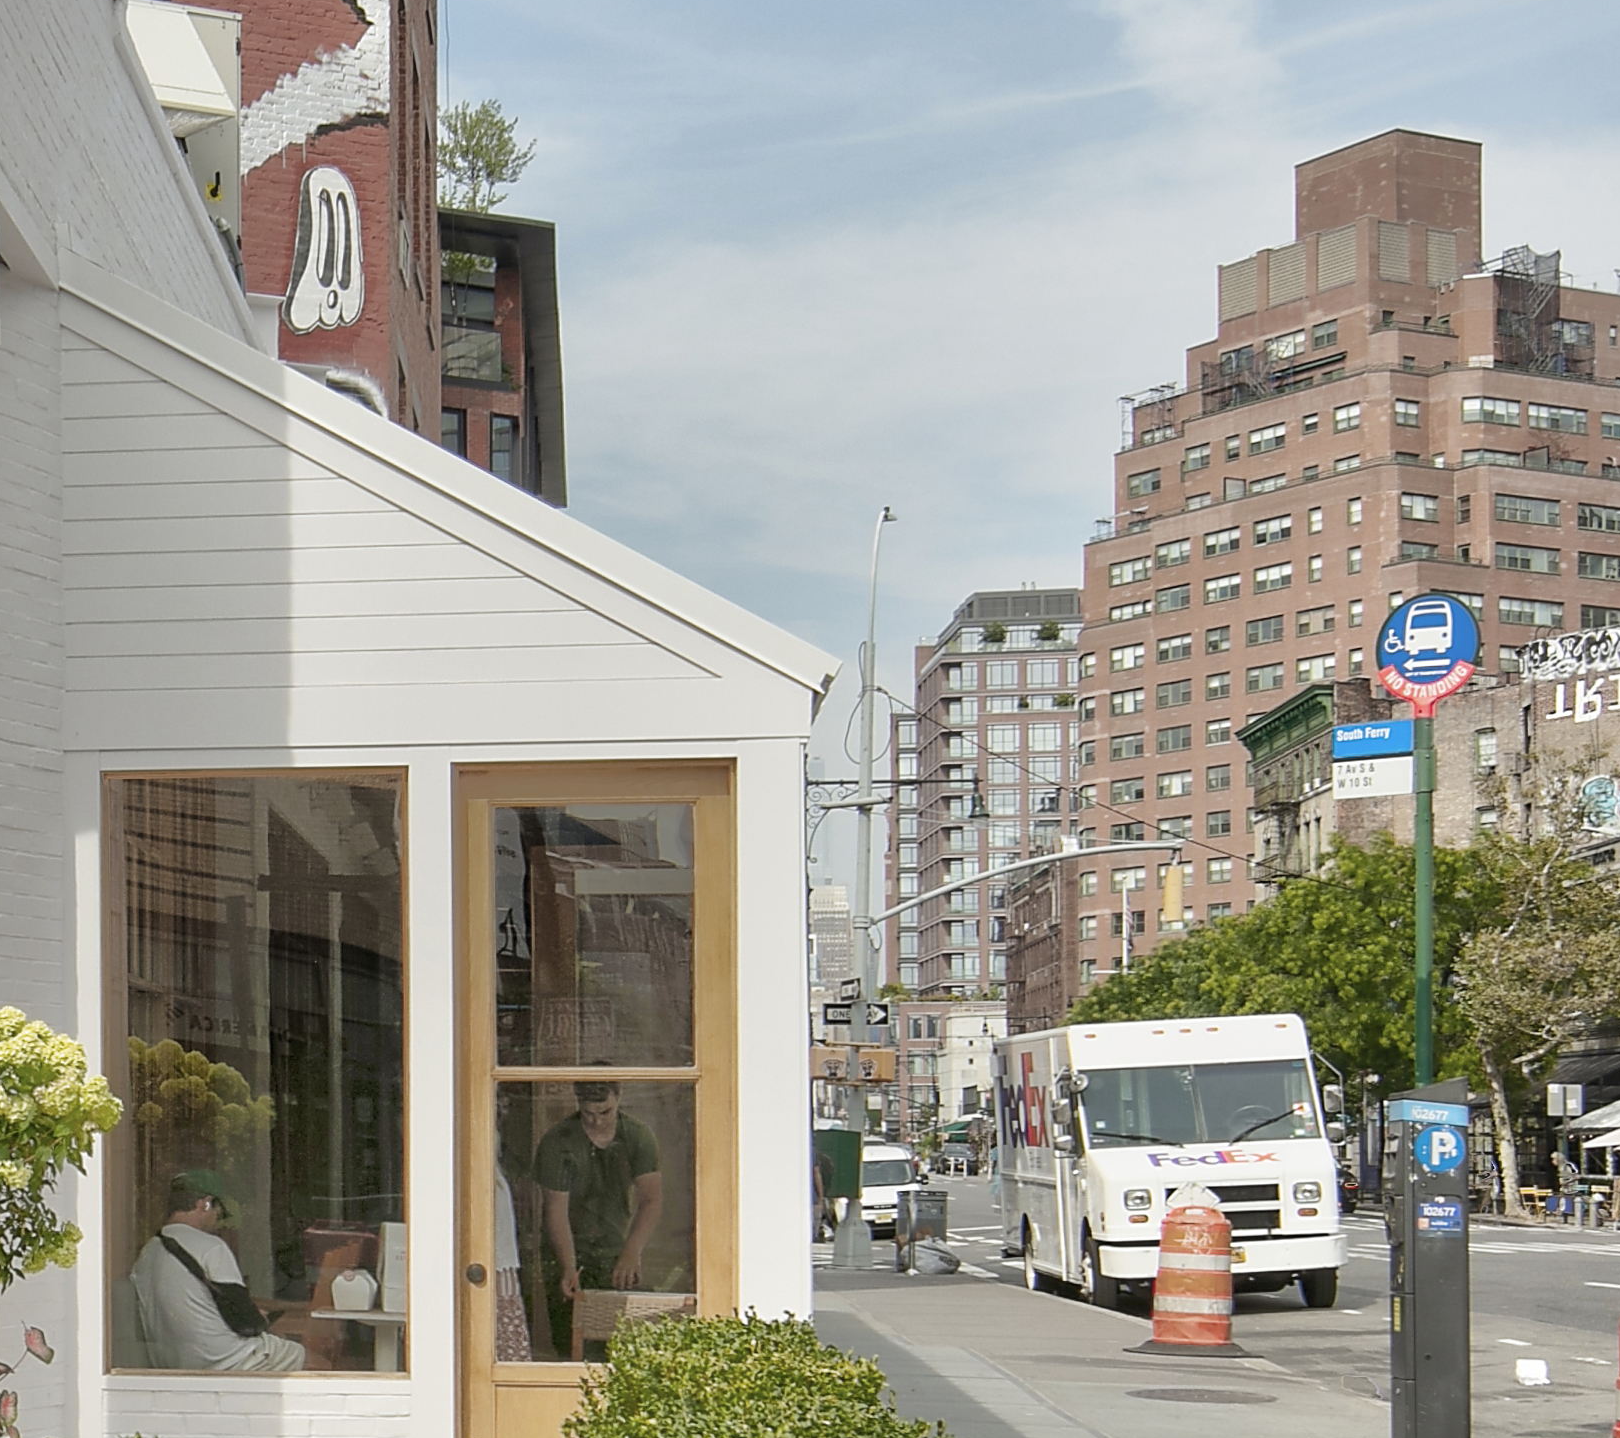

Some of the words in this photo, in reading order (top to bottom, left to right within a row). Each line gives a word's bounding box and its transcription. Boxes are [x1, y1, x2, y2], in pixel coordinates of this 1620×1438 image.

[1385, 670, 1401, 689] NO
[1404, 665, 1468, 698] STANDING
[1336, 729, 1362, 742] South
[1365, 726, 1390, 739] Ferry
[1346, 765, 1356, 773] Av
[1359, 764, 1365, 772] S
[1338, 779, 1345, 788] W
[1349, 778, 1359, 787] 10
[1363, 777, 1371, 786] St
[832, 1010, 850, 1018] ONE
[866, 1011, 879, 1019] AY
[1412, 1109, 1448, 1121] 102677
[1147, 1149, 1281, 1167] FedEx
[1423, 1207, 1455, 1217] 102677
